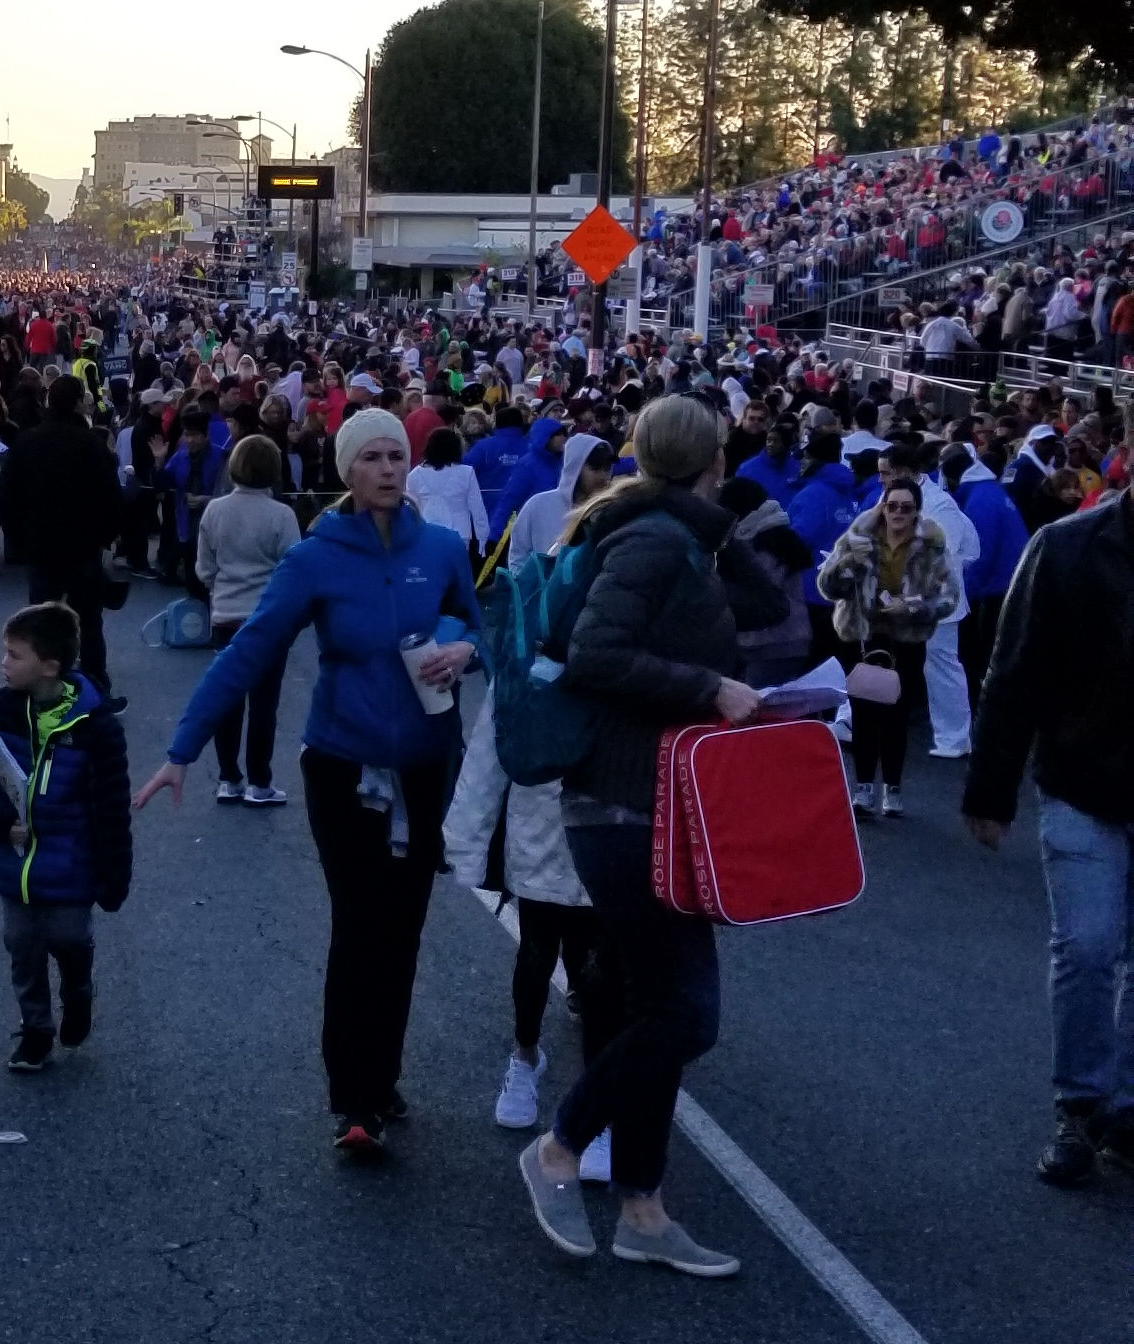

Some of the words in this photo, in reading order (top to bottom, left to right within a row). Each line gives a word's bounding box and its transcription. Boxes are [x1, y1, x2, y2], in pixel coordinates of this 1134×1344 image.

[586, 239, 611, 248] WORK
[587, 225, 612, 234] ROAD
[655, 735, 671, 828] PARADE
[678, 751, 700, 844] PARADE
[653, 837, 665, 898] ROSE
[694, 853, 717, 915] ROSE
